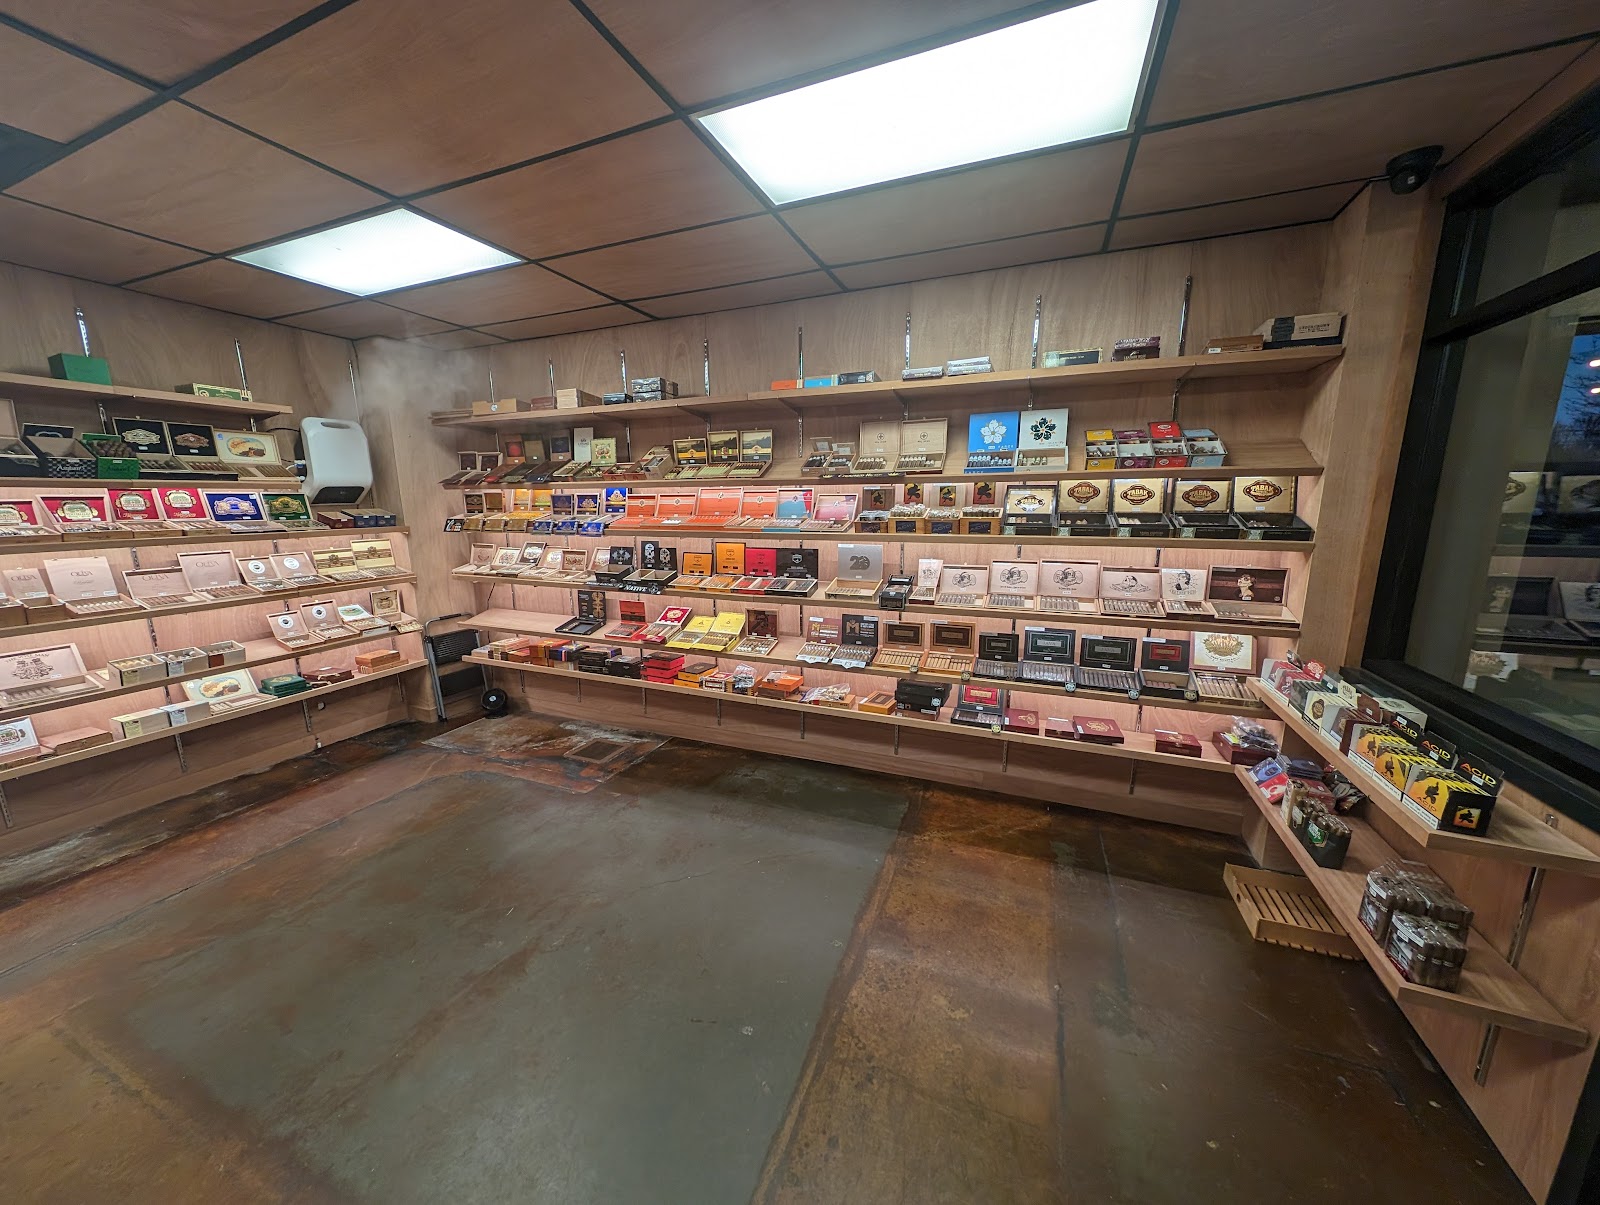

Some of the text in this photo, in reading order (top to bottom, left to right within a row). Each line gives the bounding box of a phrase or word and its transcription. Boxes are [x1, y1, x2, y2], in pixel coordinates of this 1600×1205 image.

[1189, 489, 1212, 497] TABAK
[1250, 484, 1274, 492] TABAK
[195, 560, 220, 568] OLIVA
[10, 574, 37, 582] OLIVA
[1392, 720, 1418, 737] ACID
[1422, 740, 1451, 759] ACID
[1460, 762, 1497, 785] ACID
[1416, 796, 1437, 812] ACID
